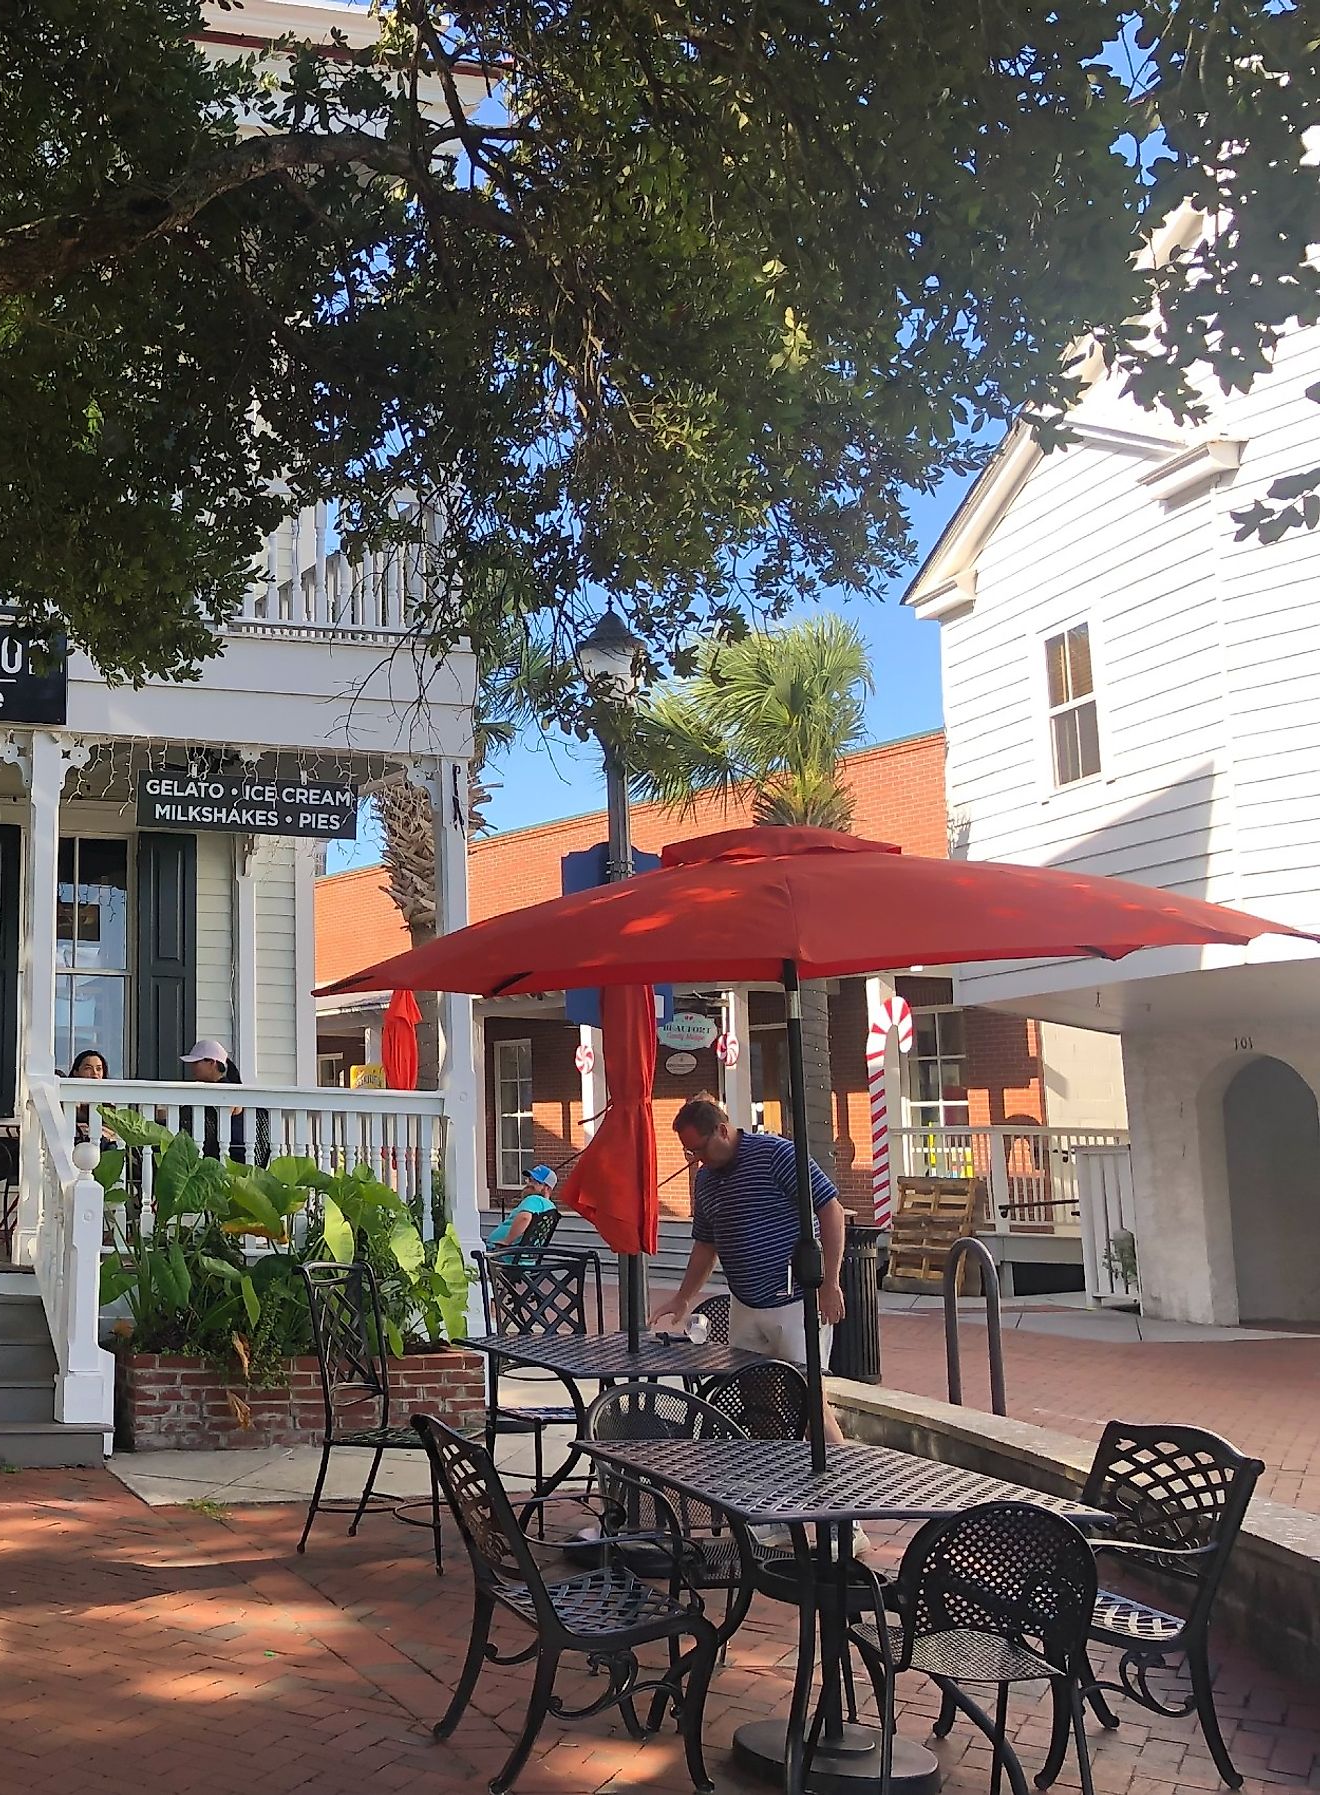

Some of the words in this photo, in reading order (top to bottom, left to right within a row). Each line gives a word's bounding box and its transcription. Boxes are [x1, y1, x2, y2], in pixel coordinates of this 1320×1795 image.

[145, 779, 224, 799] GELATO
[245, 784, 277, 801] ICE
[281, 787, 351, 807] CREAM
[155, 803, 279, 827] MILKSHAKES
[298, 813, 341, 830] PIES
[1234, 1036, 1253, 1050] 101
